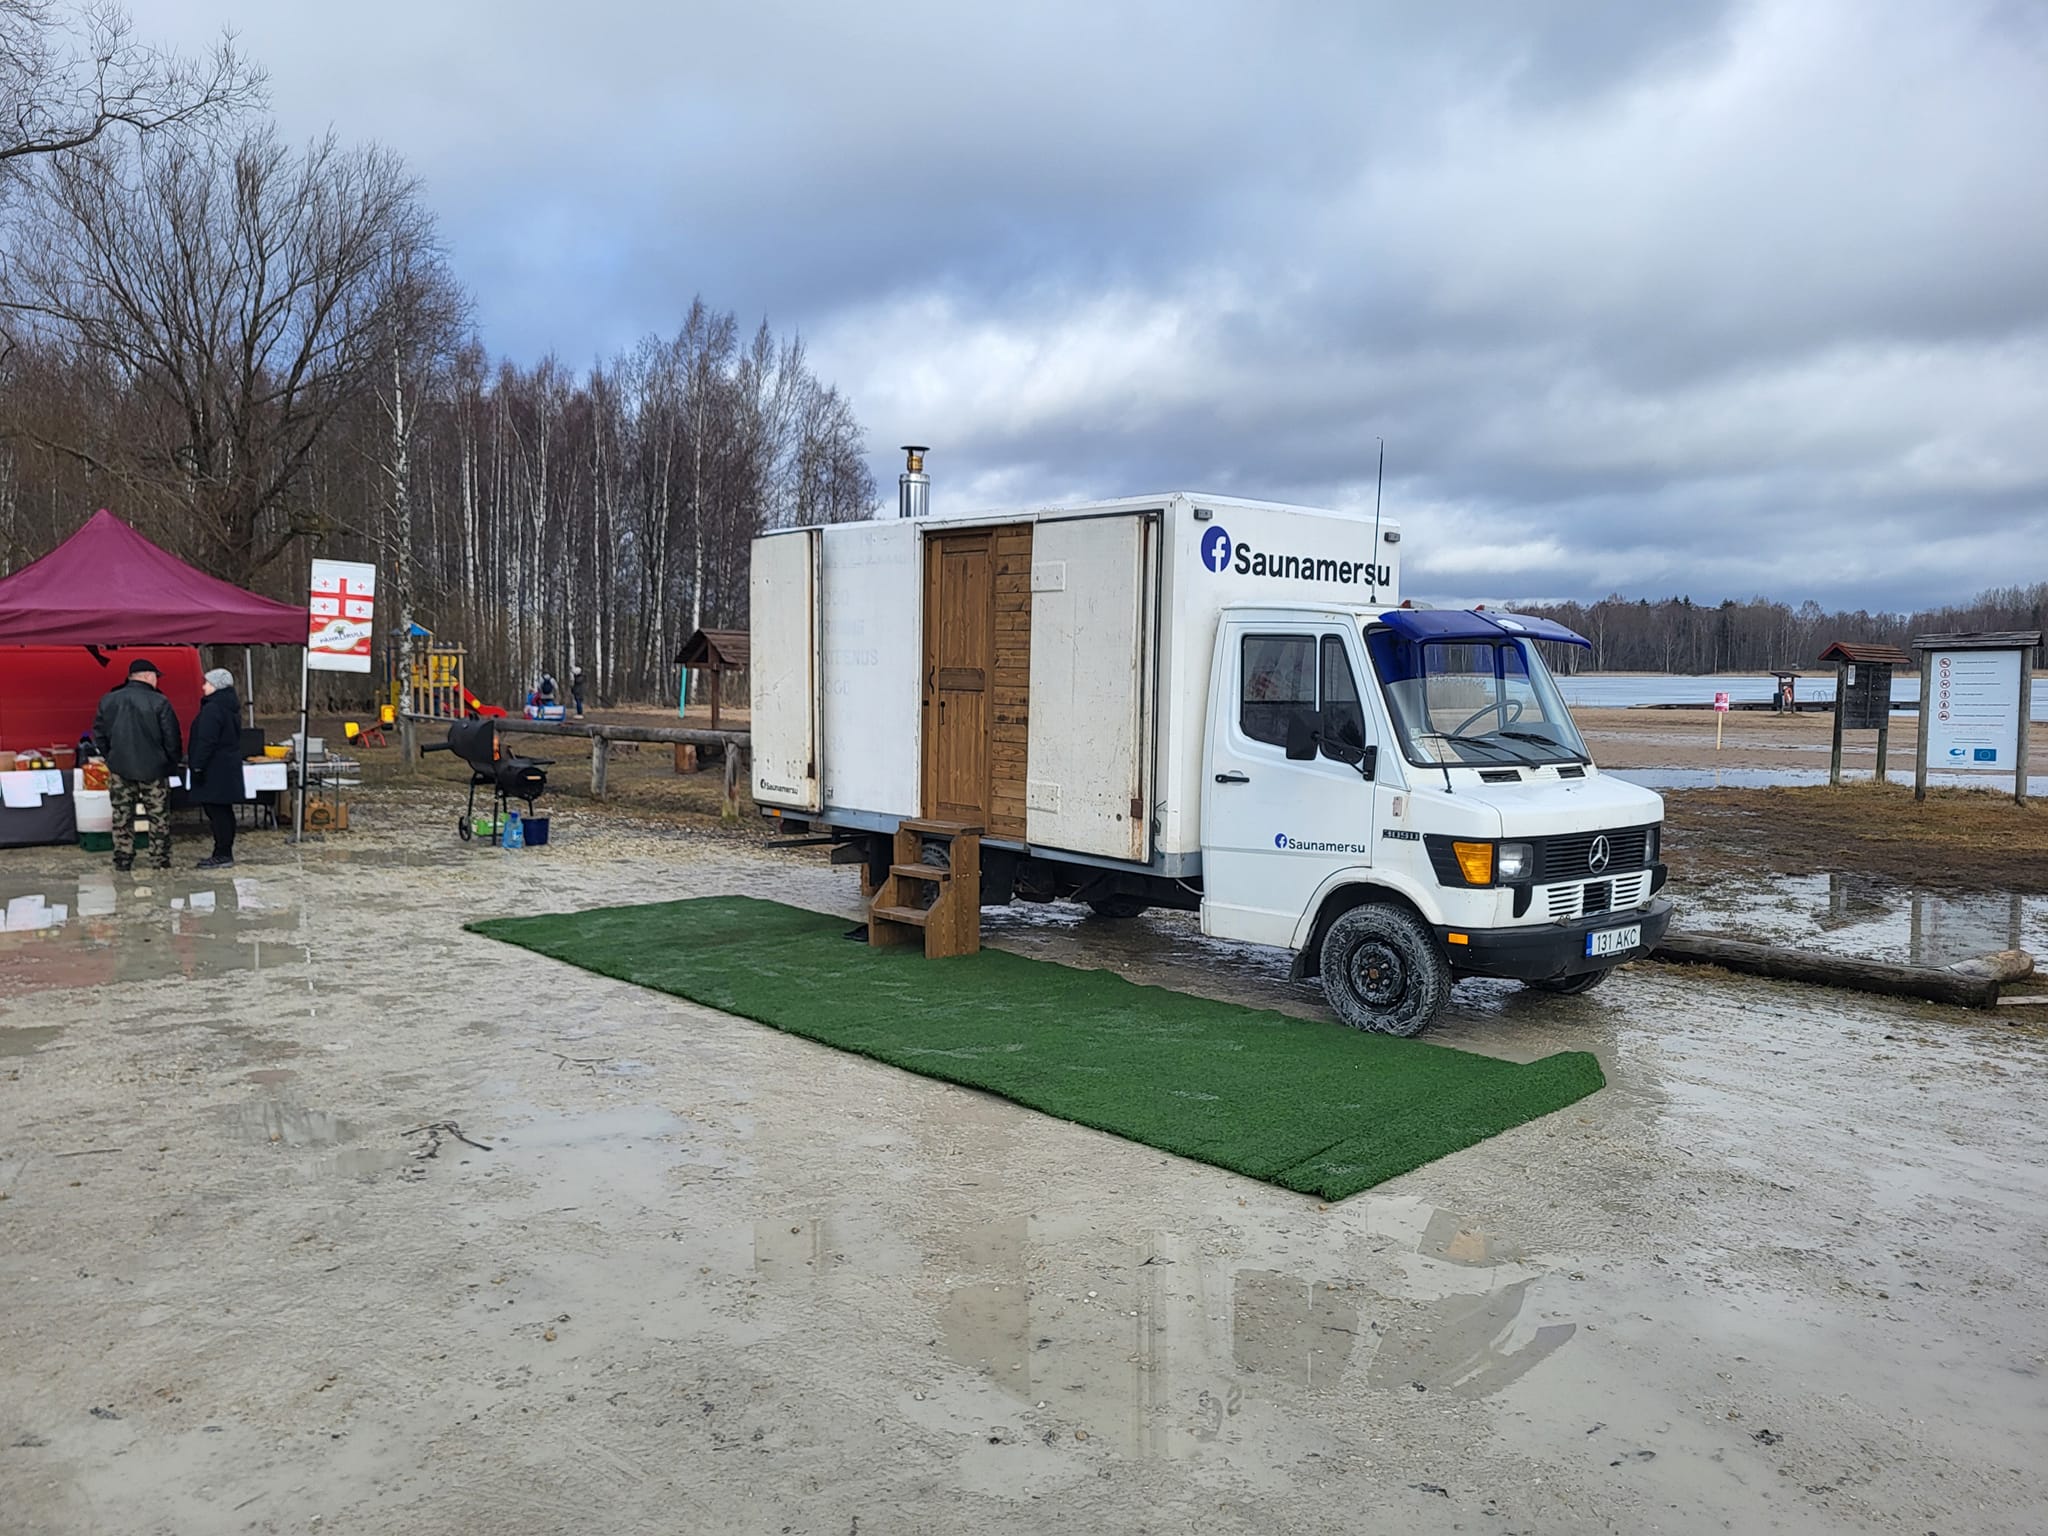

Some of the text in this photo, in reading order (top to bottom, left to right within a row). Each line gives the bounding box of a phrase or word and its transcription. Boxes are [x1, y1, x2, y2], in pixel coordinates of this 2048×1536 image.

[1234, 542, 1391, 588] Saunamersu
[1288, 838, 1366, 854] Saunamersu
[1597, 928, 1637, 953] 131 AKC
